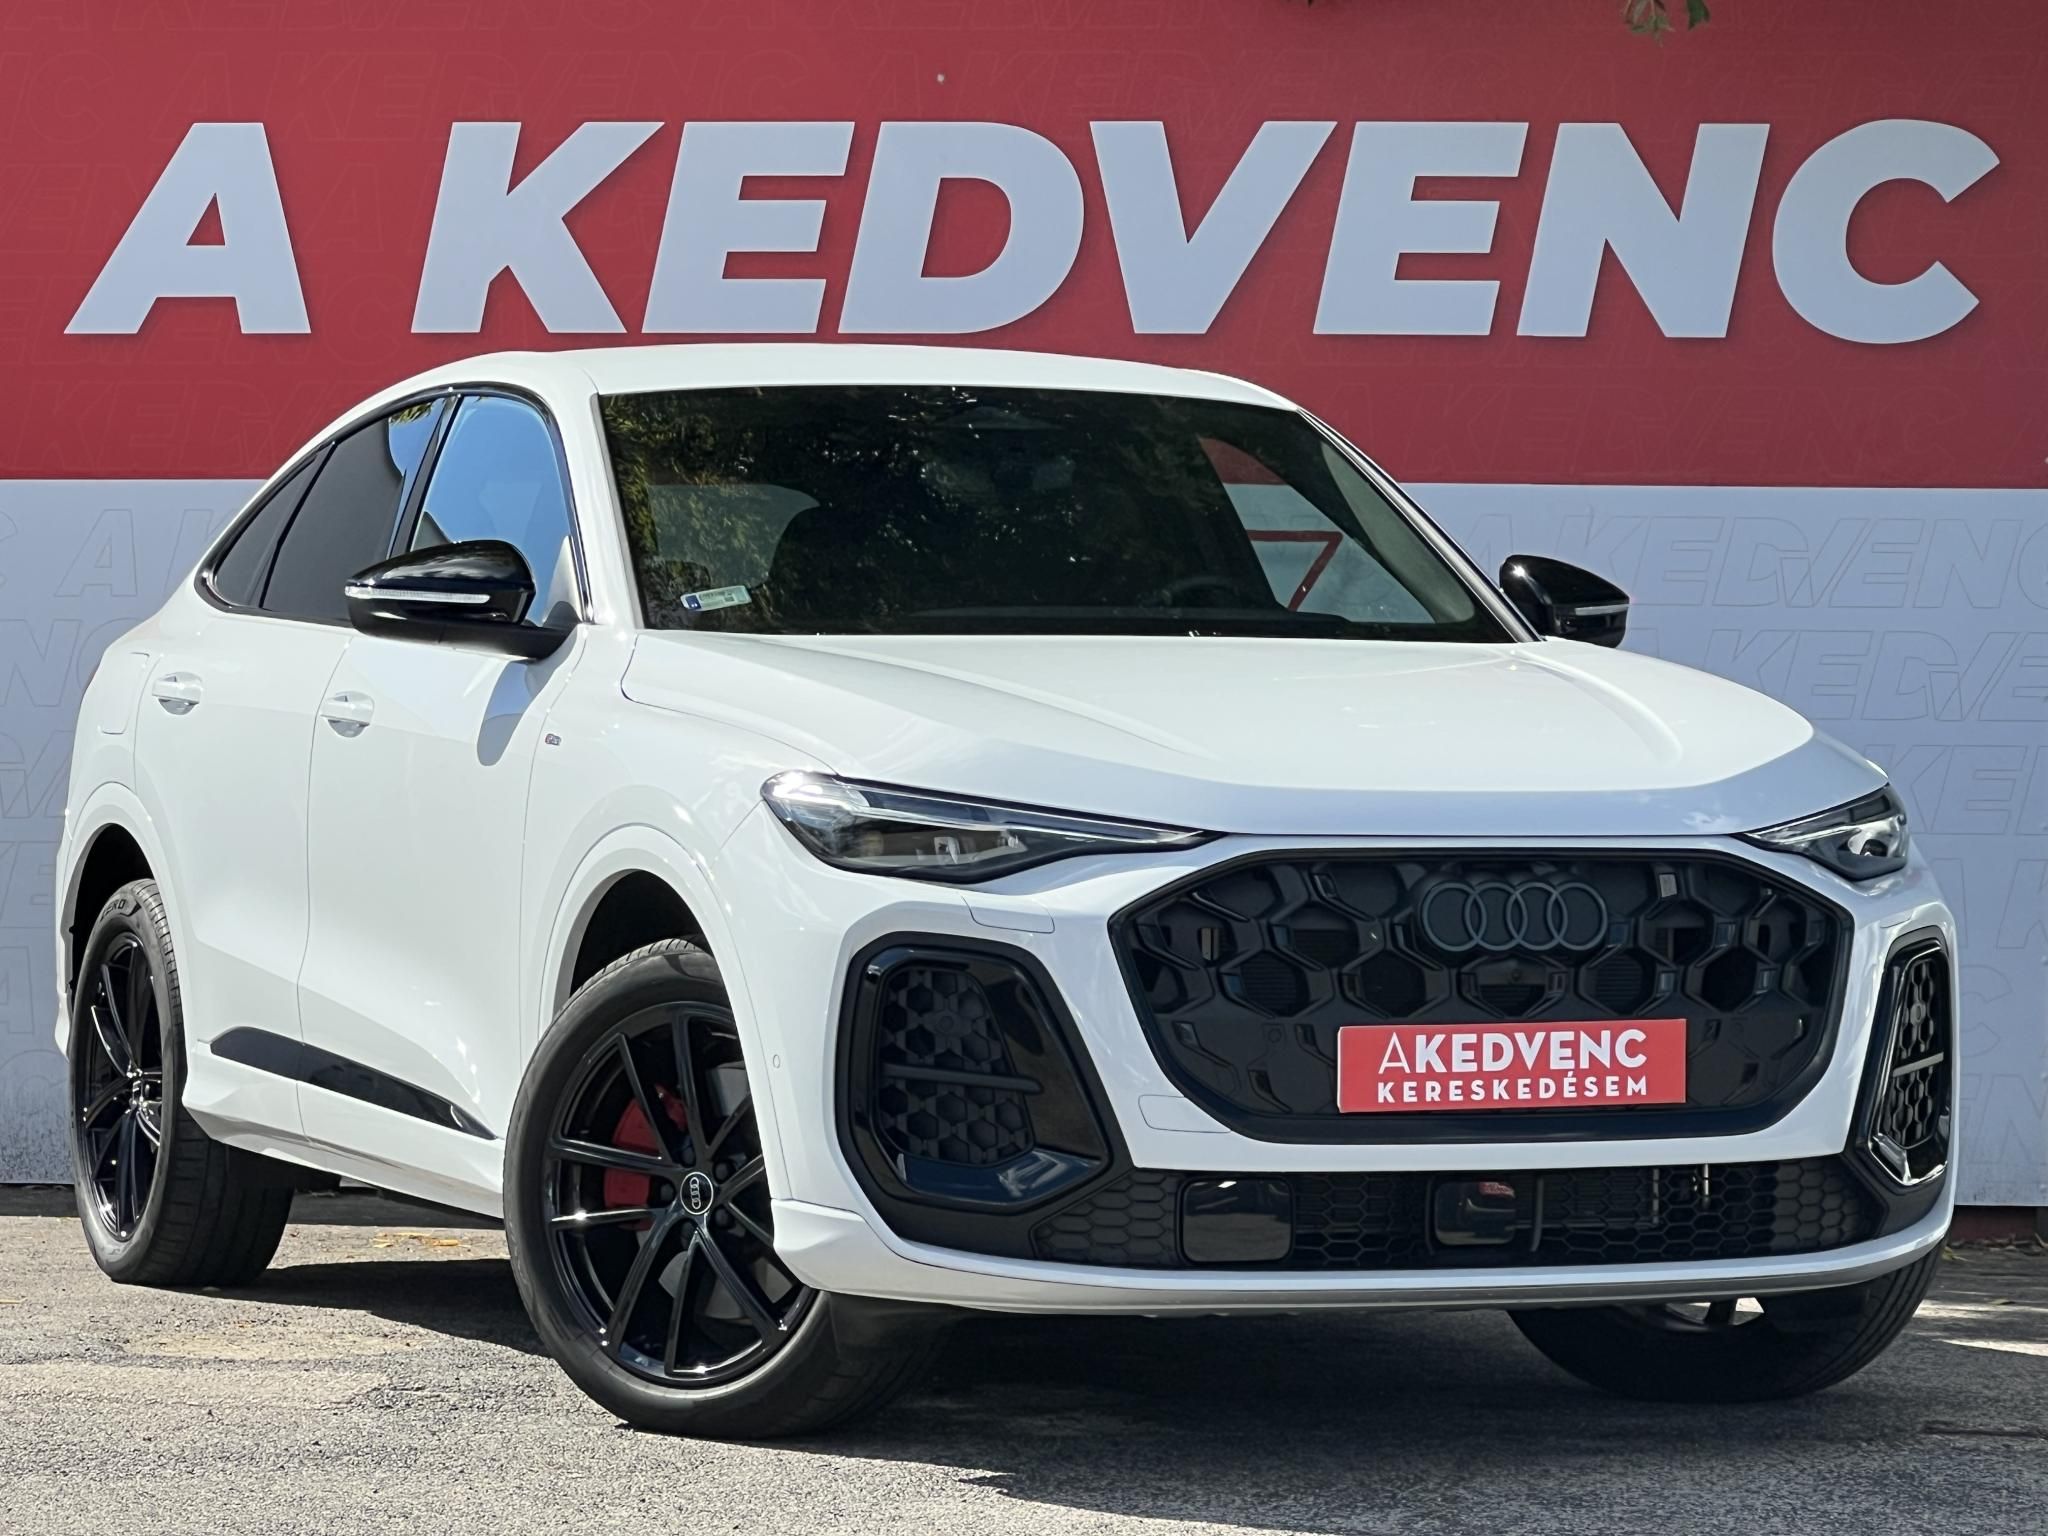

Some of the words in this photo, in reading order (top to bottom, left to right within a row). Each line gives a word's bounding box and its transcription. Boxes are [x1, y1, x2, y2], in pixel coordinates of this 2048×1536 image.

[64, 123, 311, 334] A
[411, 120, 1999, 344] KEDVENC
[1377, 1071, 1647, 1104] KERESKEDÉSEM
